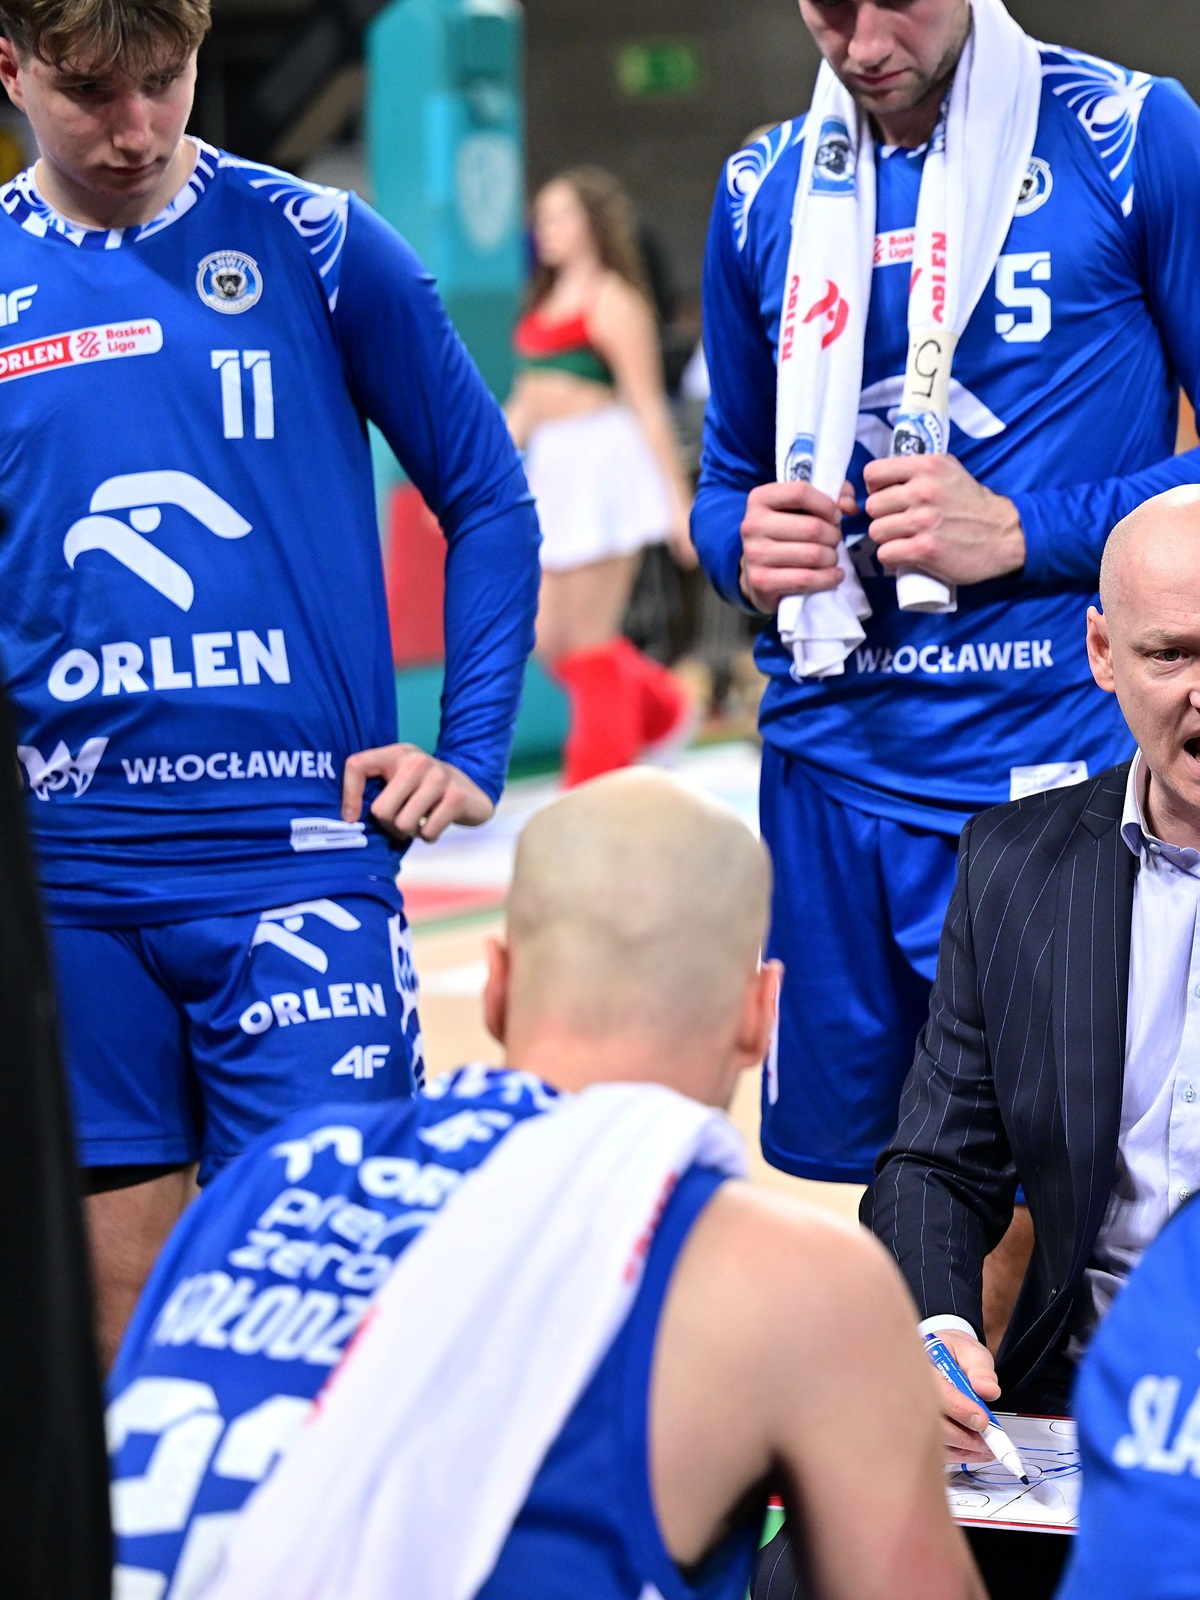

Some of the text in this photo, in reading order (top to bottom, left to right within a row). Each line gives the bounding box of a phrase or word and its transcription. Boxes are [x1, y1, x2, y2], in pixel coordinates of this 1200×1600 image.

[889, 232, 915, 246] Bask
[0, 284, 39, 328] F
[994, 251, 1052, 343] 5
[106, 324, 151, 340] Basket
[107, 340, 136, 354] Liga
[210, 350, 275, 440] 11
[48, 629, 291, 702] ORLEN
[856, 639, 1055, 675] WŁOCŁAWEK
[121, 750, 337, 785] WŁOCŁAWEK
[239, 982, 388, 1035] ORLEN
[331, 1044, 391, 1080] 4F
